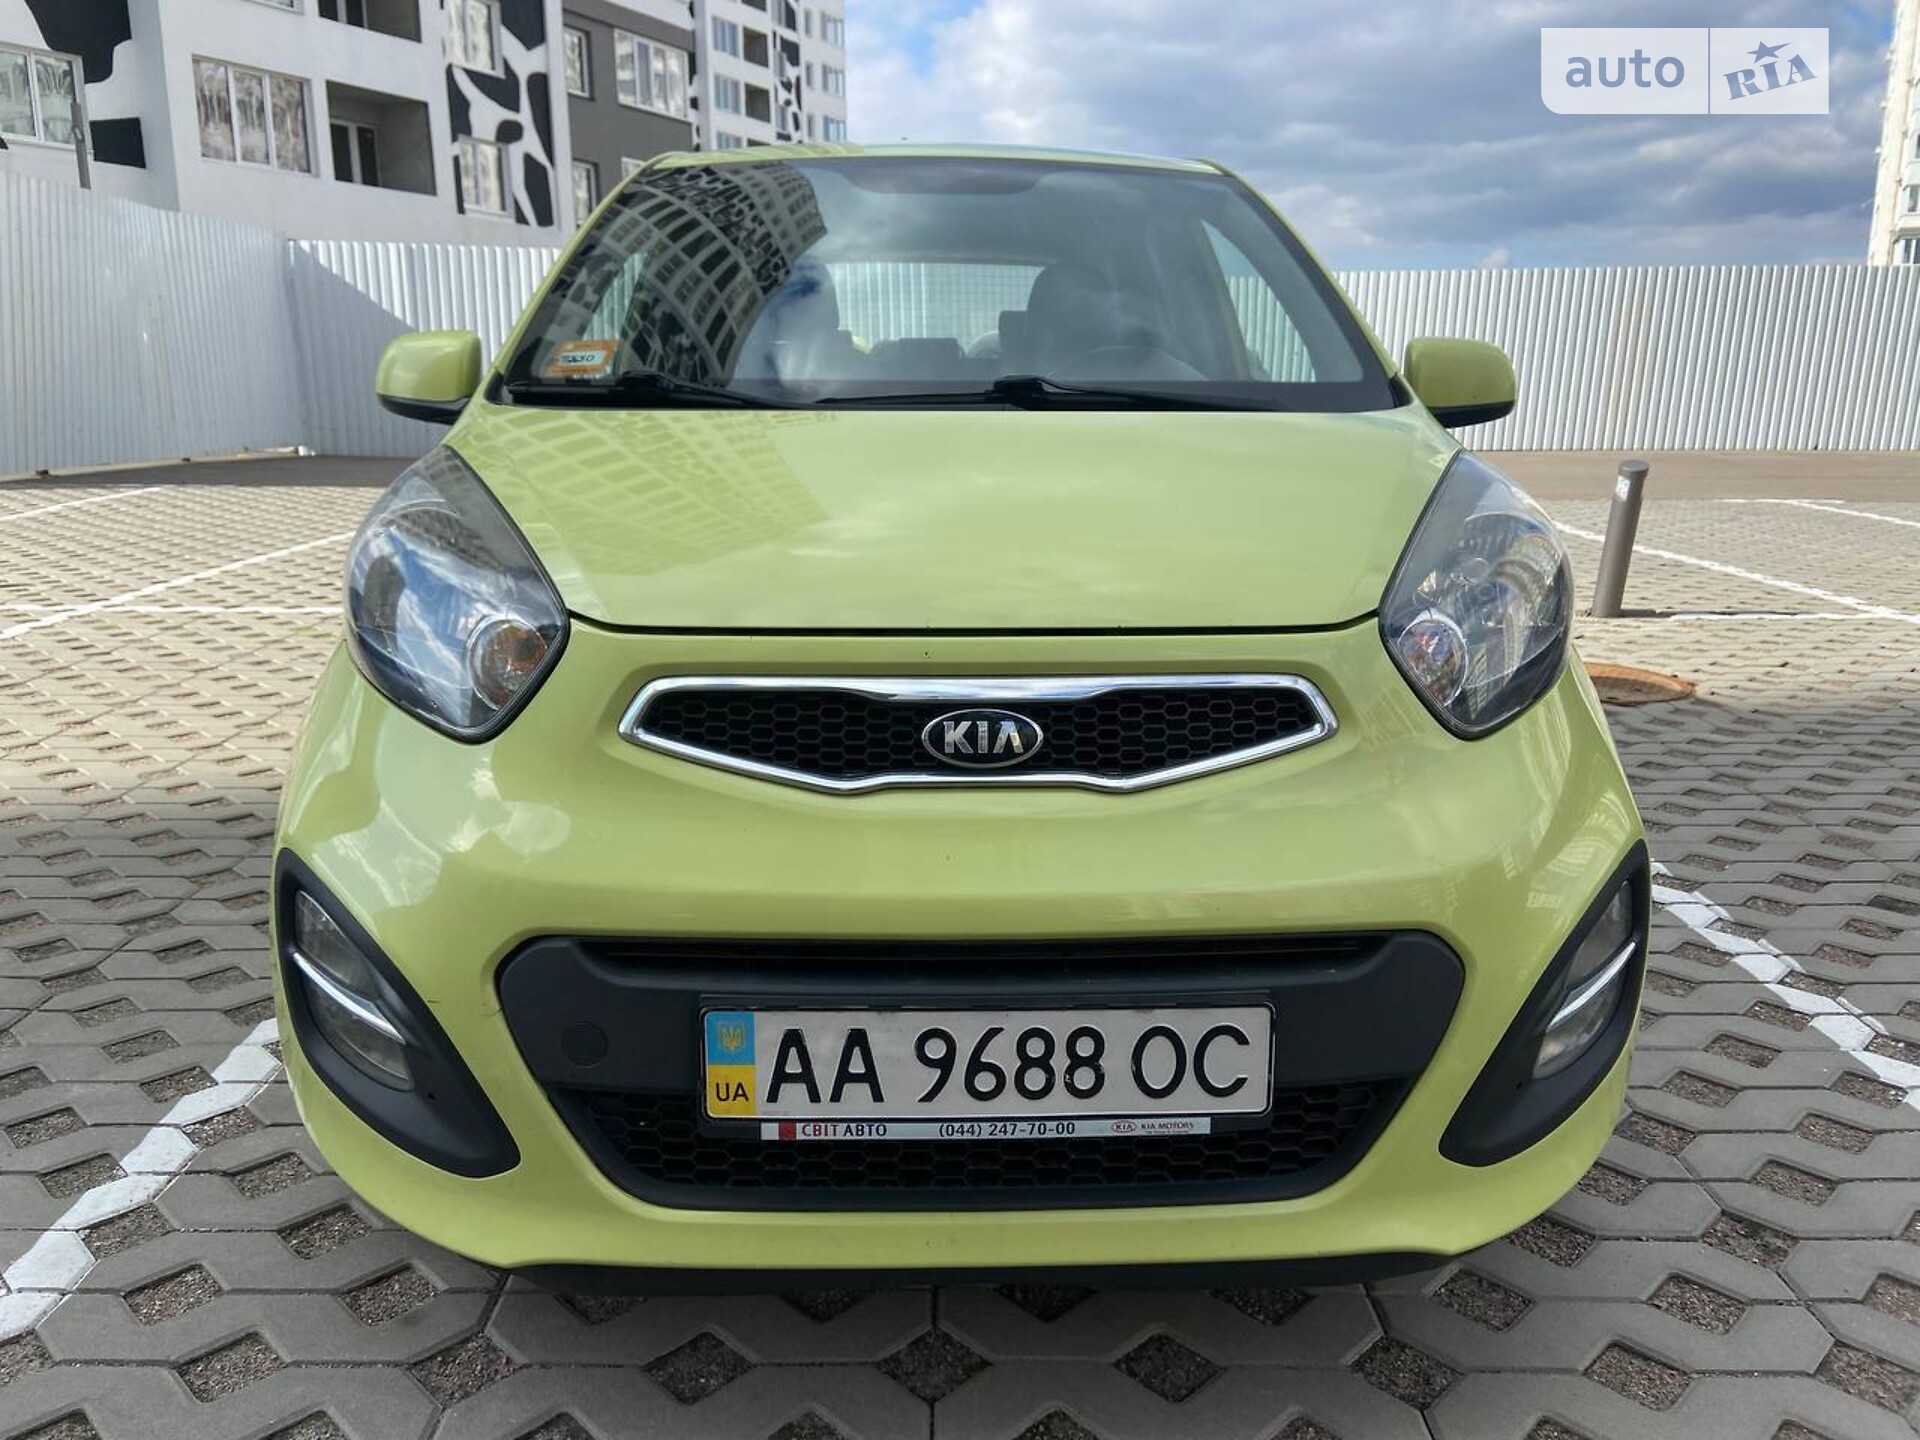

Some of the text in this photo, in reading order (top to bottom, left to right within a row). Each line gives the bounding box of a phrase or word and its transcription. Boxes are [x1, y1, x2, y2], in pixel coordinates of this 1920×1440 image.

[943, 720, 1024, 754] KIA
[765, 1024, 1250, 1104] AA 9688 OC
[715, 1082, 749, 1102] UA
[801, 1122, 888, 1138] СВІТ АВТО
[938, 1121, 1076, 1138] (044) 247-70-00
[1140, 1120, 1194, 1130] KIA MOTORS
